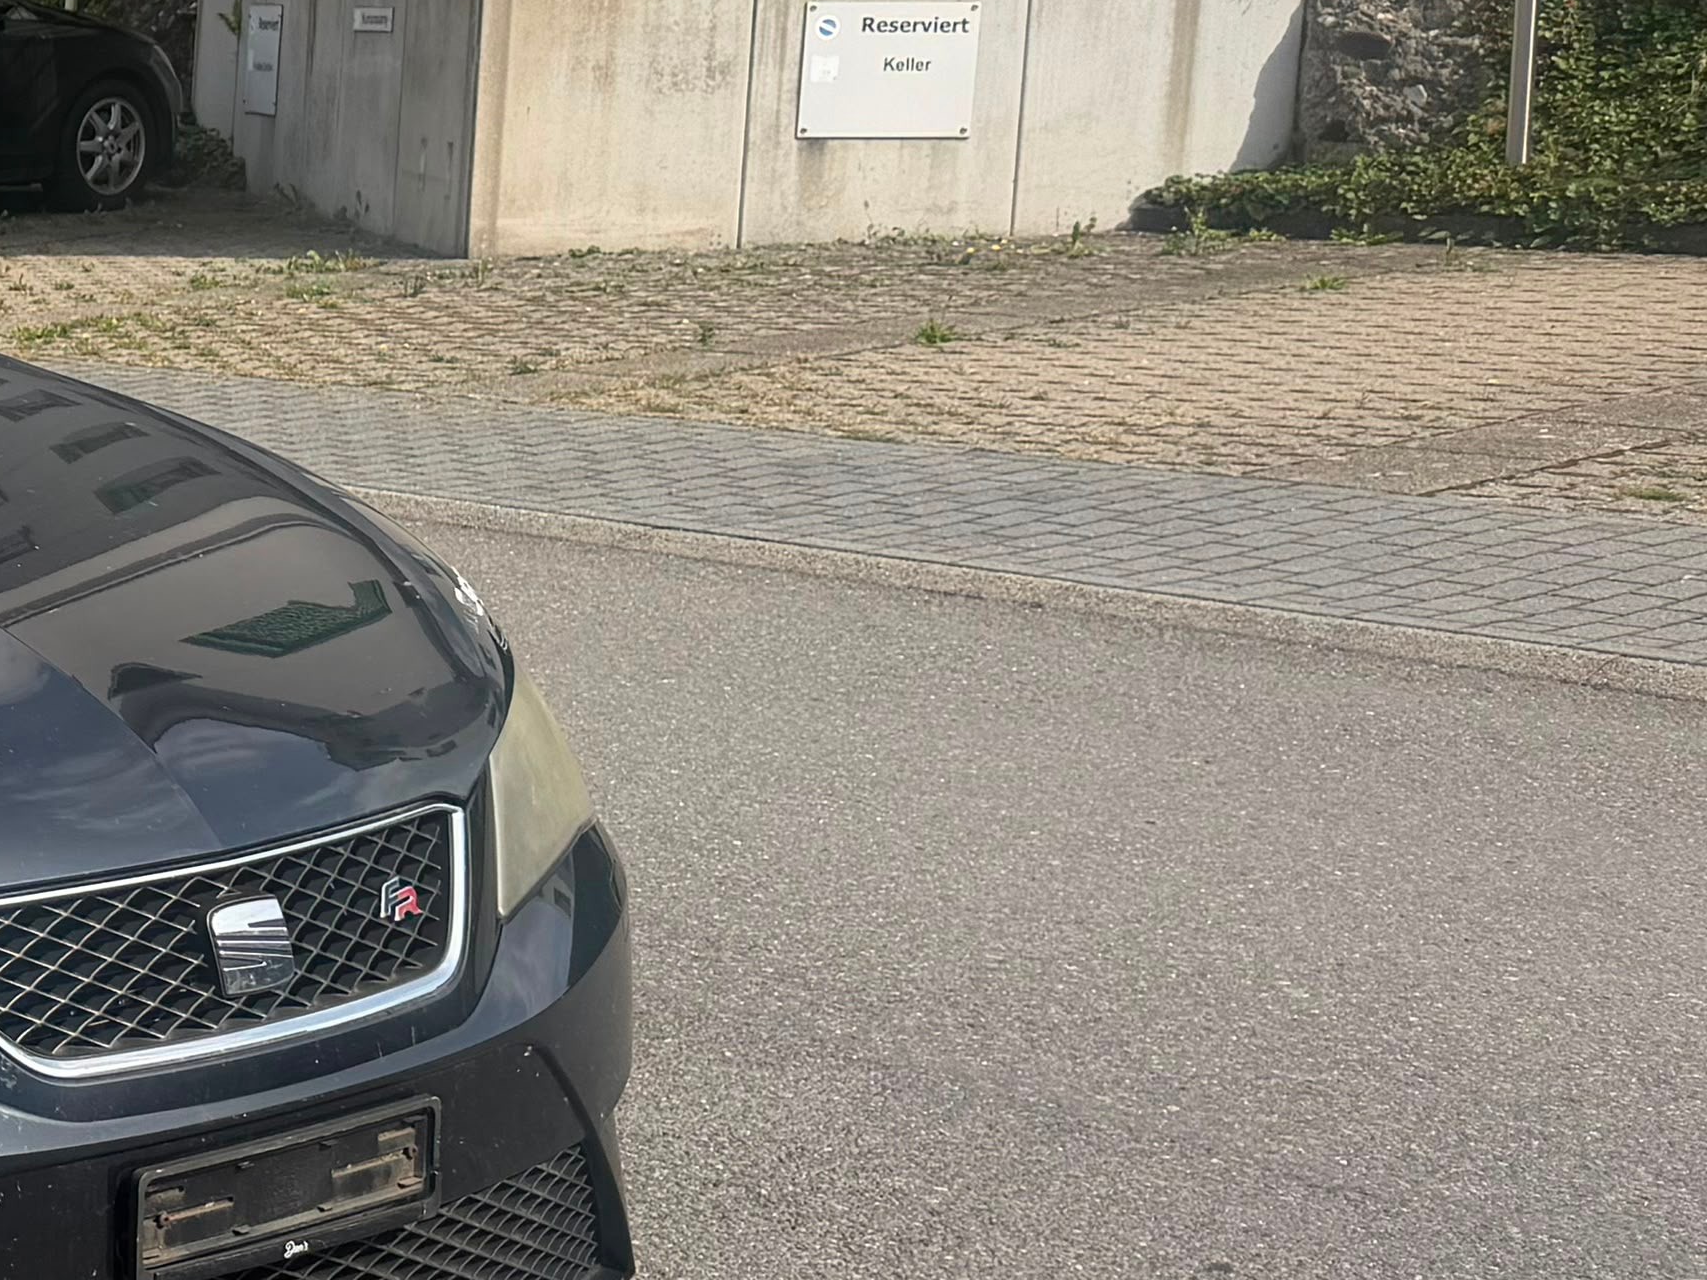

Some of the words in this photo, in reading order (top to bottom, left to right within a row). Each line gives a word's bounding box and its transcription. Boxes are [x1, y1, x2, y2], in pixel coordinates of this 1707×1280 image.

[861, 16, 970, 33] Reserviert
[883, 57, 931, 72] Keller
[380, 876, 423, 921] FR
